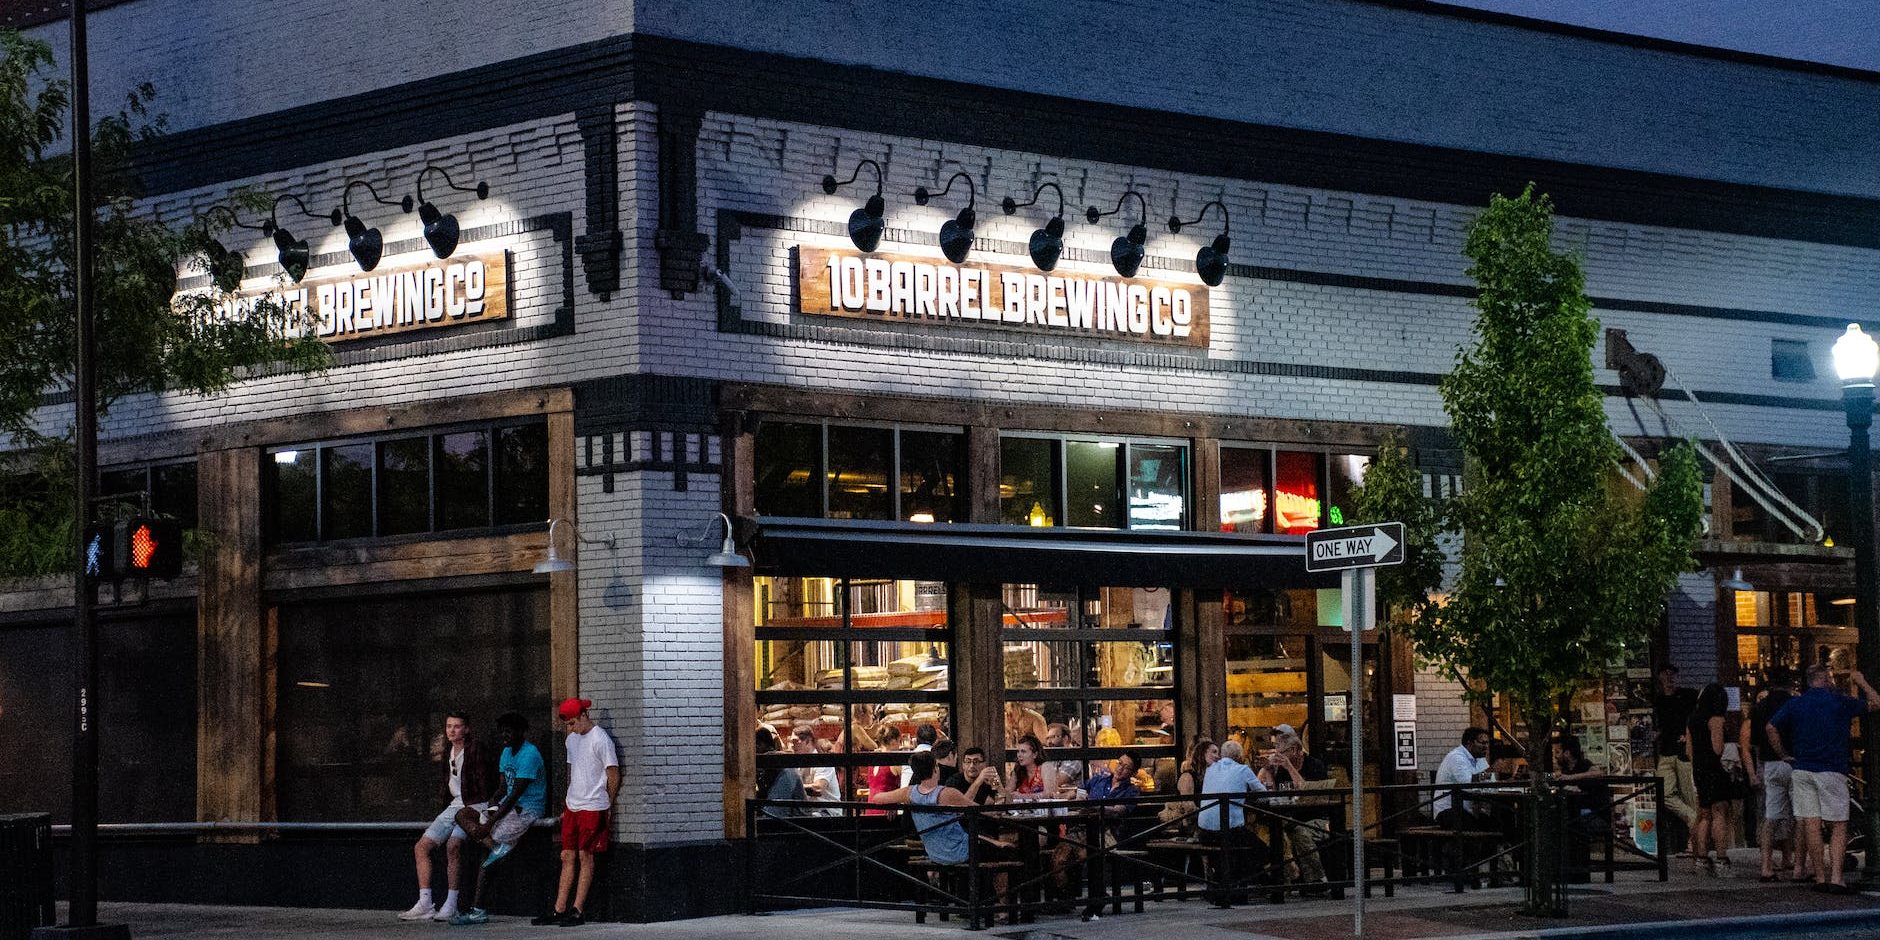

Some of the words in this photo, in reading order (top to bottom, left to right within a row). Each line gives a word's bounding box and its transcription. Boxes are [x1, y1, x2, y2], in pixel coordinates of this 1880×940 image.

[316, 267, 445, 336] BREWING
[827, 254, 864, 309] 10
[866, 258, 1002, 321] BARREL
[1001, 272, 1149, 334] BREWING
[1316, 541, 1342, 558] ONE
[1346, 538, 1373, 555] WAY
